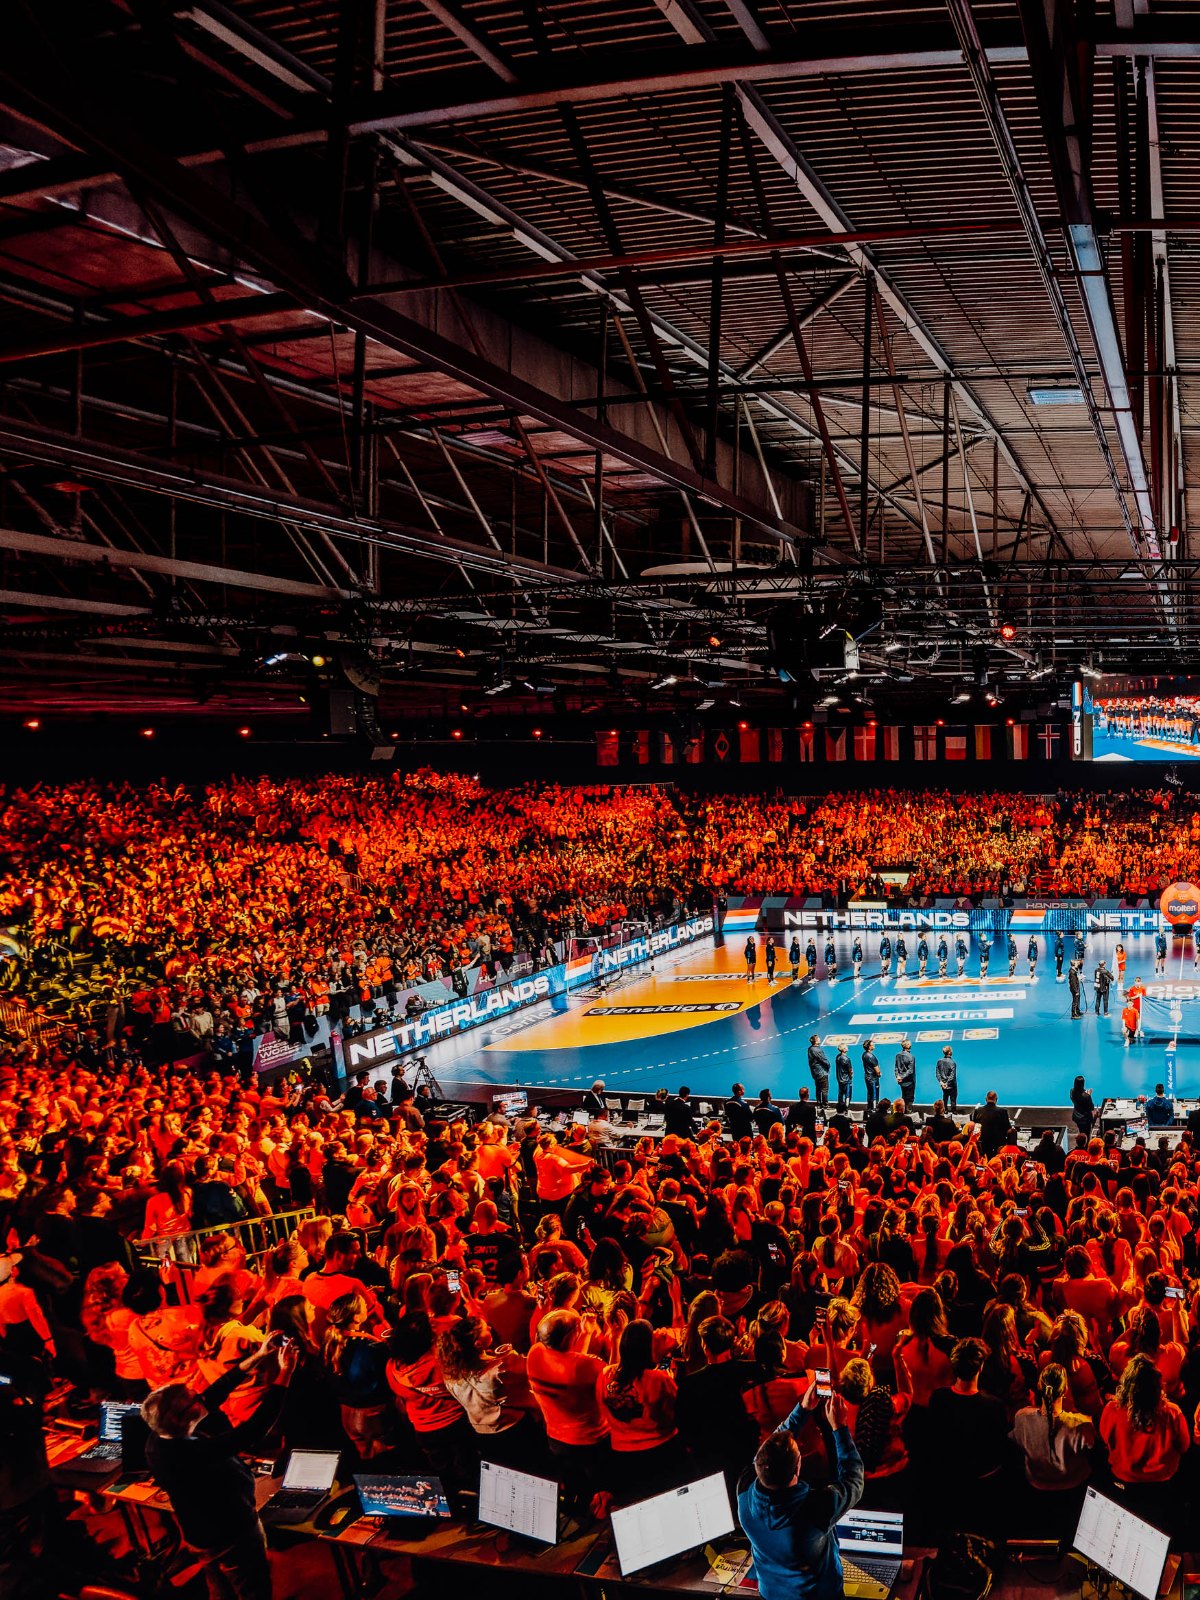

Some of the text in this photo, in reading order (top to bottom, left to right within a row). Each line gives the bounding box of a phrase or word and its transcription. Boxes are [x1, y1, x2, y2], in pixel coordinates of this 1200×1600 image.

[784, 911, 970, 926] NETHERLANDS
[1169, 904, 1196, 912] molten
[603, 917, 714, 968] NETHERLANDS
[350, 976, 549, 1065] NETHERLANDS
[588, 1004, 711, 1017] Gjensidige
[491, 1008, 559, 1036] Gerflor
